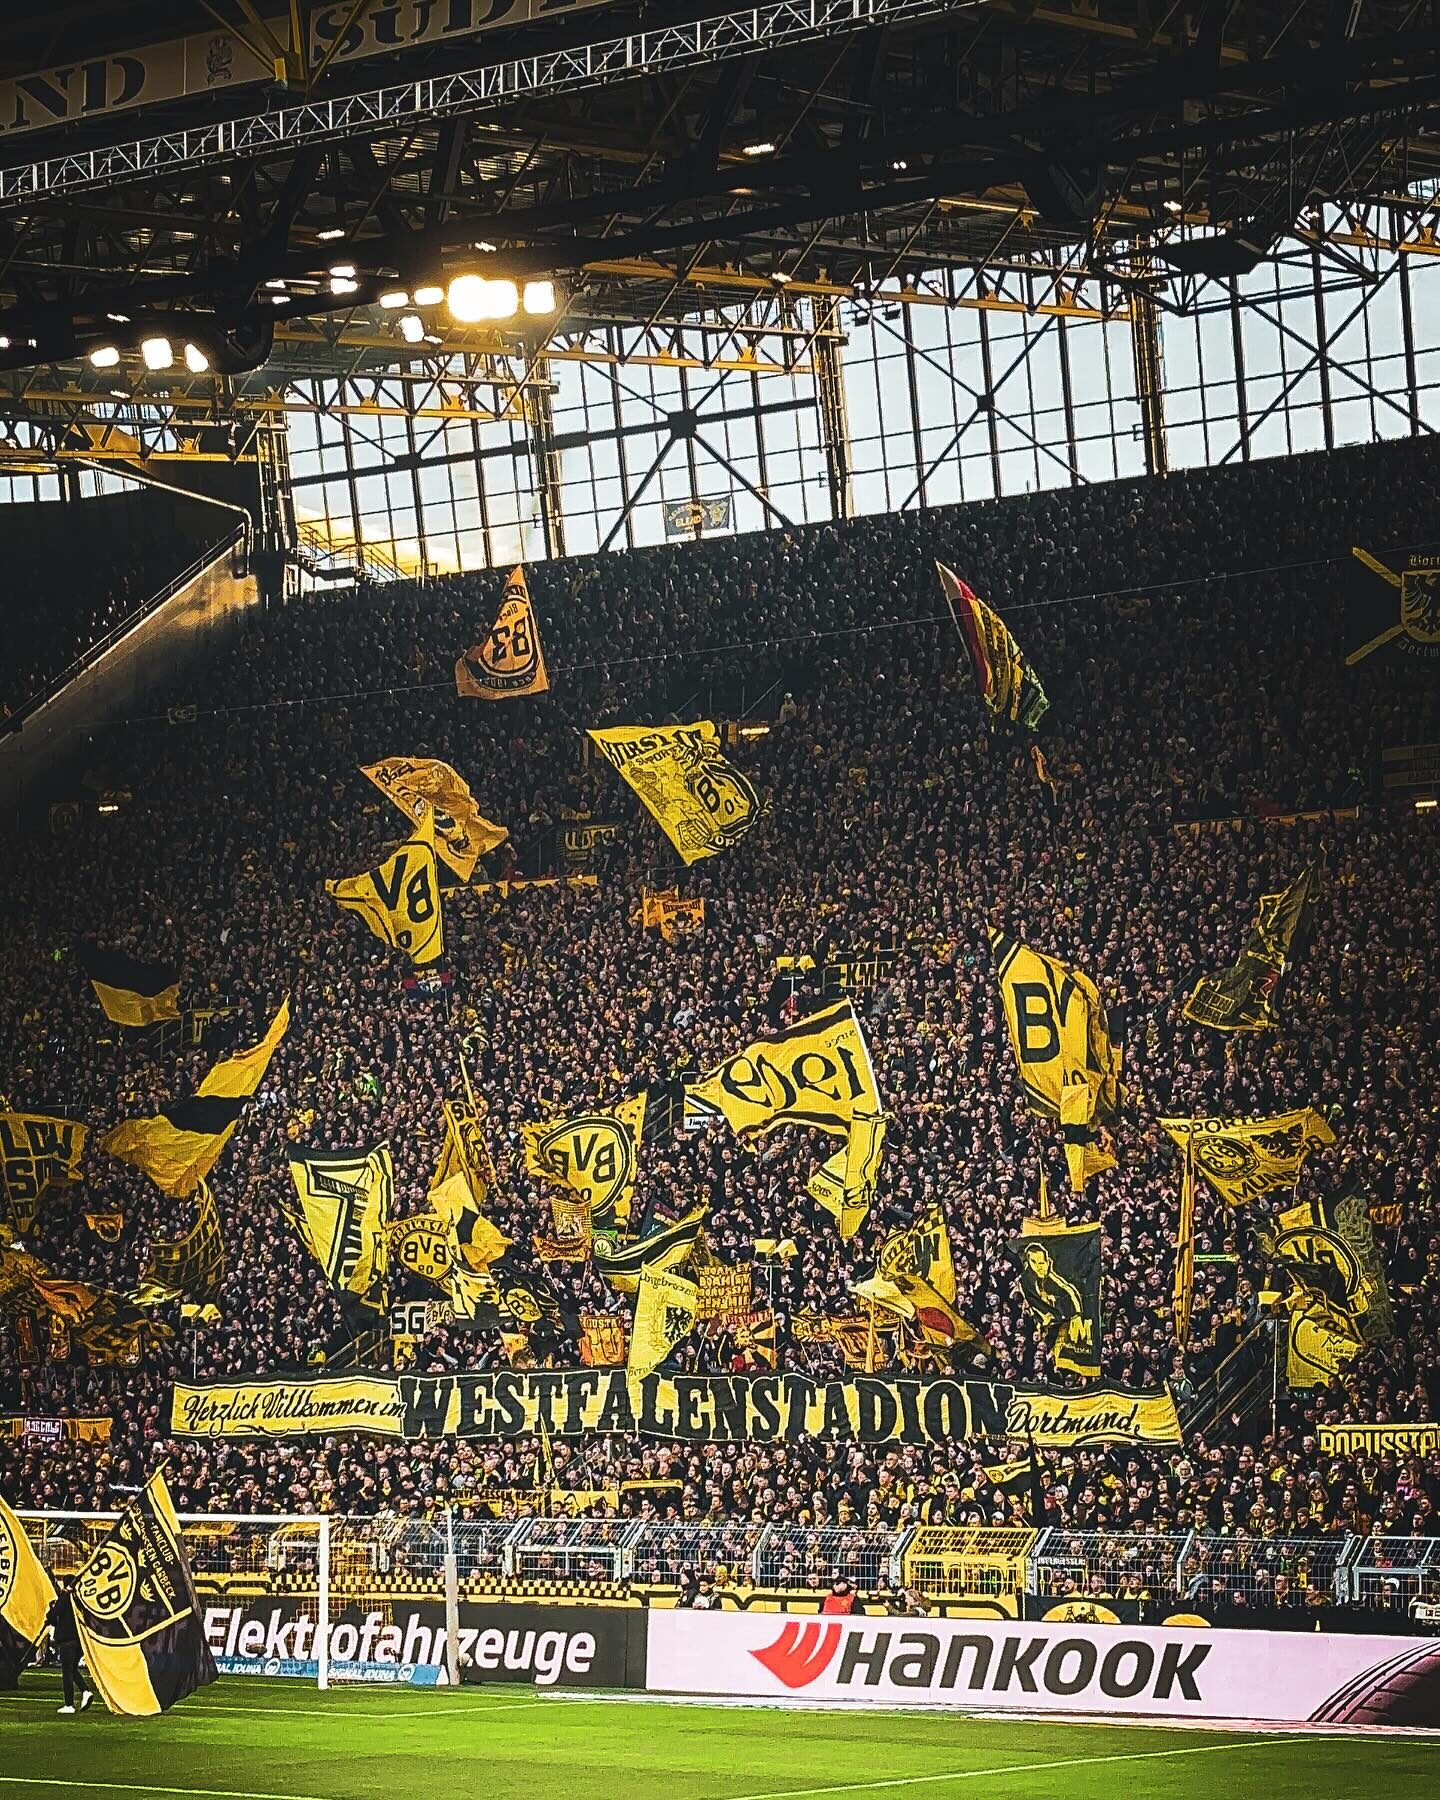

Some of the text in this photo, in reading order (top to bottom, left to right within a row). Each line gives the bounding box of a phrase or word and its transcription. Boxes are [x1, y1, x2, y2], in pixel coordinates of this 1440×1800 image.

[0, 56, 146, 127] ND
[391, 1305, 427, 1335] SG
[184, 1387, 407, 1437] Herzlich Willkommen im
[402, 1372, 1015, 1444] WESTFALENSTADION
[89, 1551, 130, 1610] BVB
[204, 1607, 597, 1686] Elektrofahrzeuge
